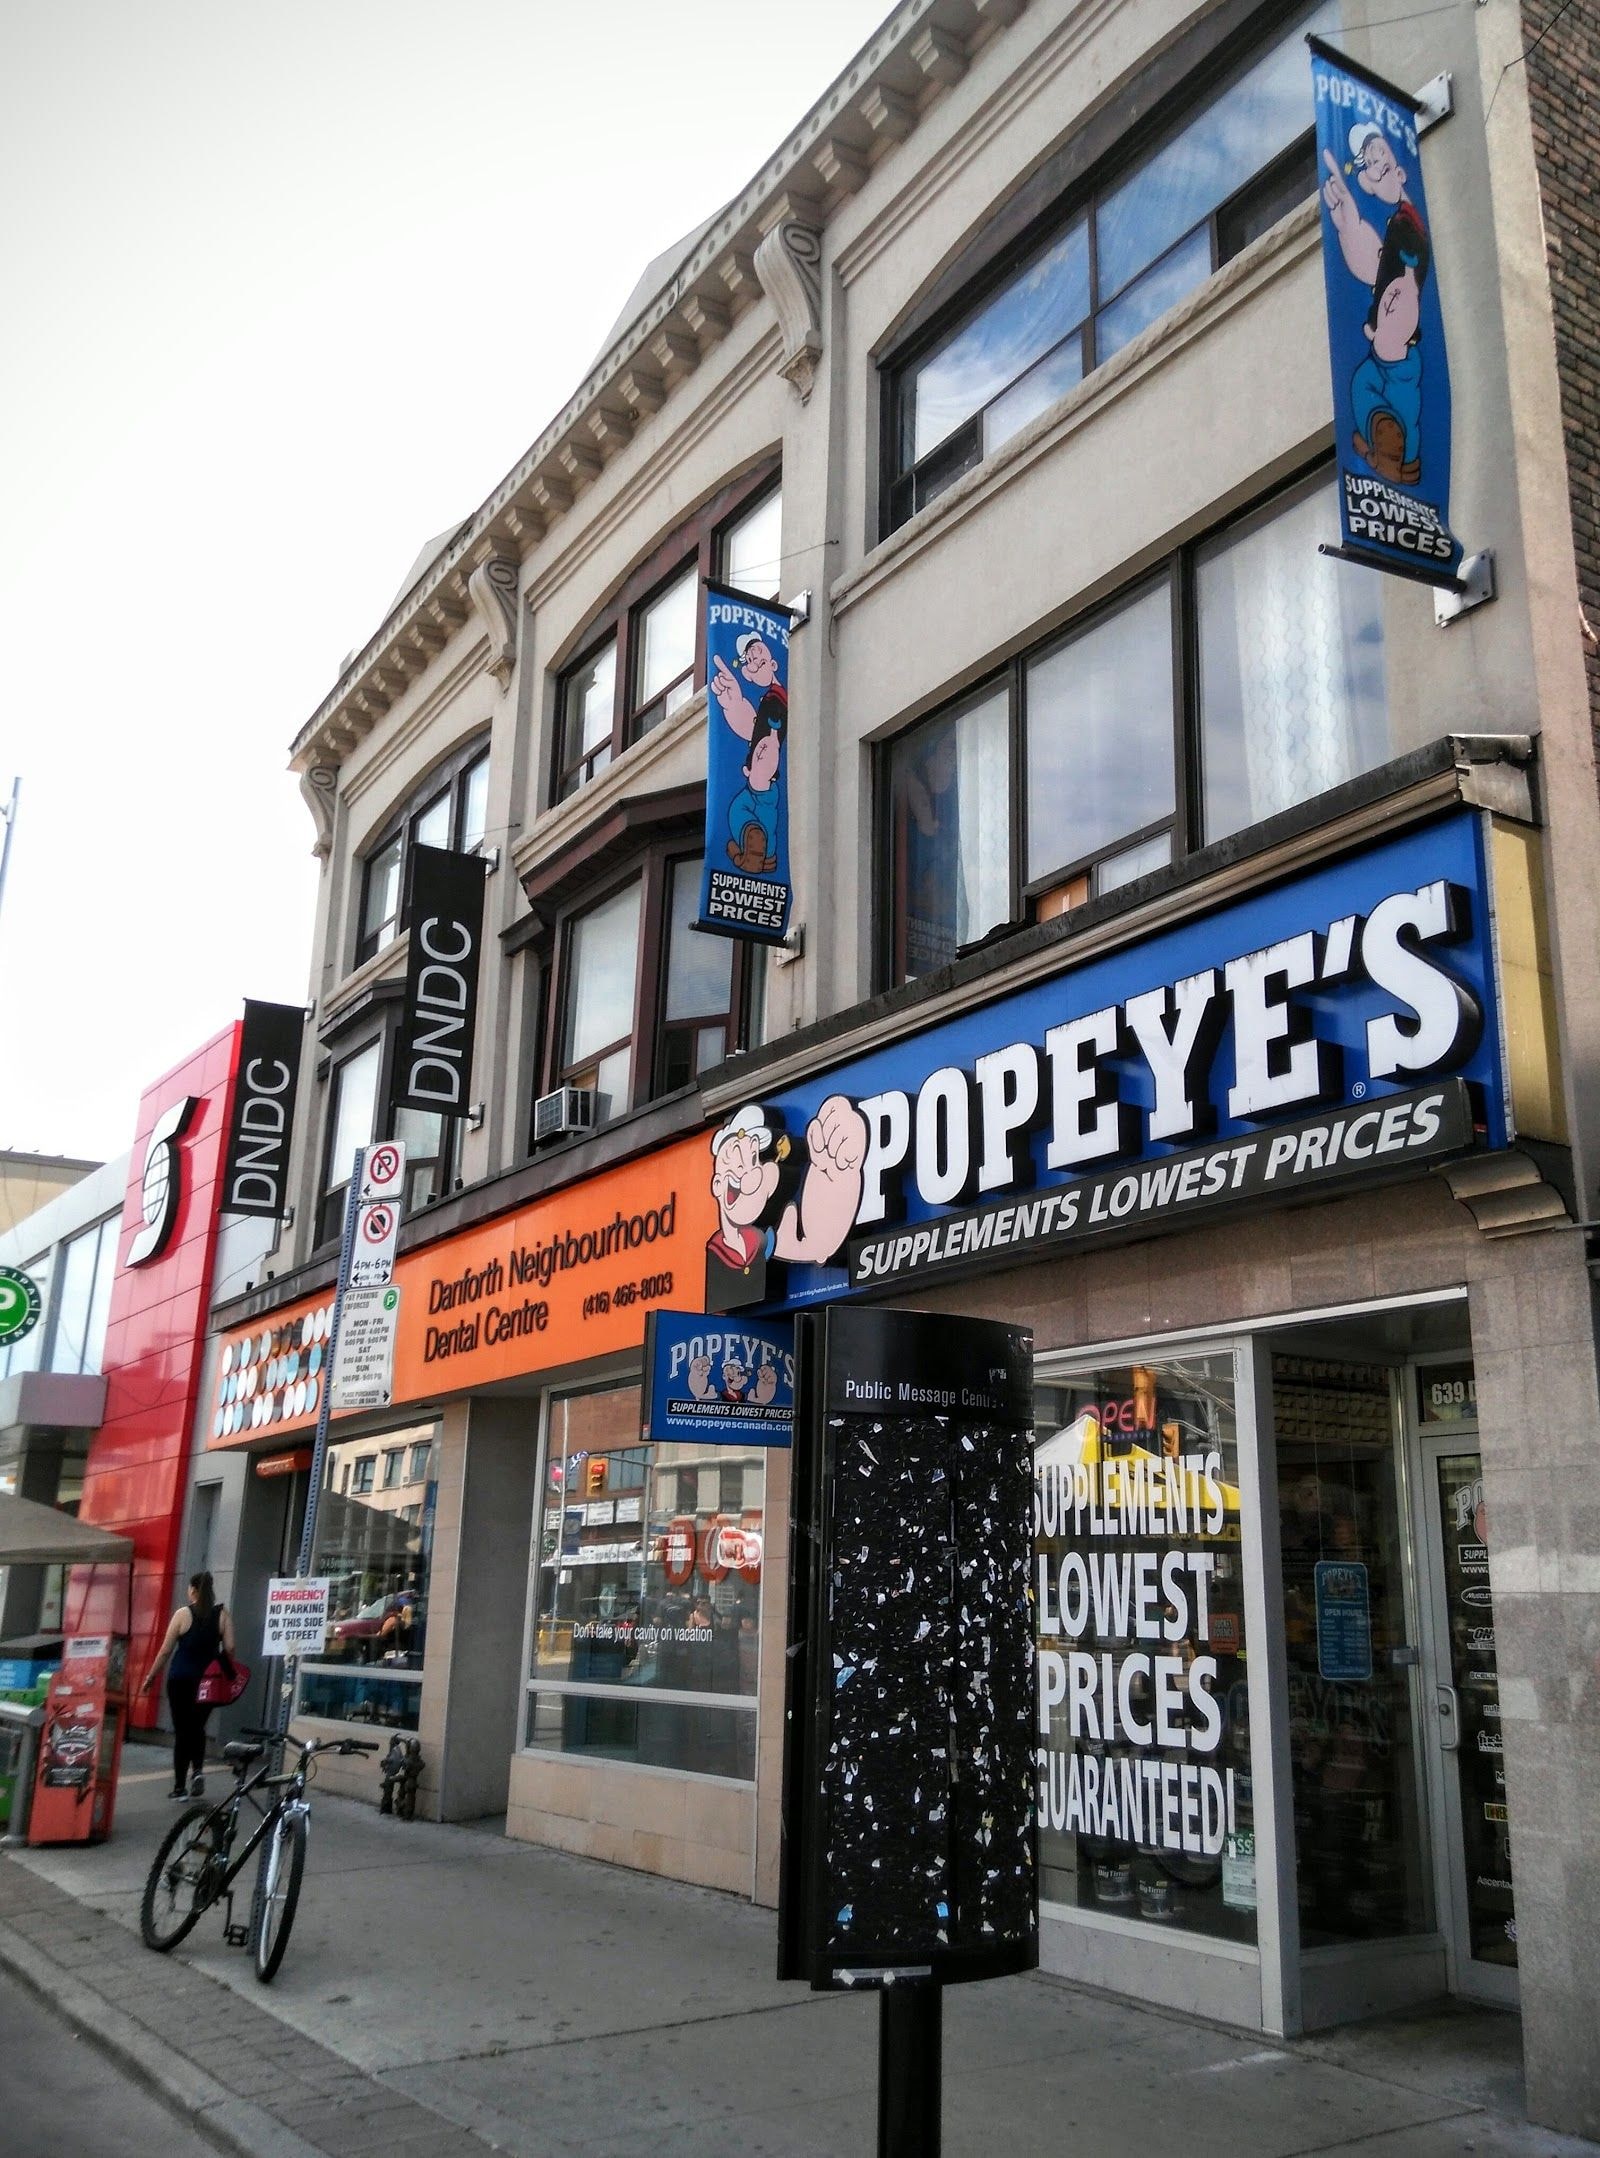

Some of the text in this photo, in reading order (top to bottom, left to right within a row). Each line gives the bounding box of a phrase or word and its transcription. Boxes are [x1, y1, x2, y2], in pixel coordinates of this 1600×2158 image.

[1316, 73, 1417, 156] POPEYE'S
[1345, 474, 1439, 523] SUPPLEMENTS
[1347, 495, 1445, 535] LOWEST
[1349, 515, 1452, 558] PRICES
[710, 604, 790, 649] POPEYE'S
[711, 887, 785, 913] LOWEST
[712, 872, 787, 899] SUPPLEMENTS
[709, 902, 783, 928] PRICES
[408, 917, 472, 1103] DNDC
[856, 879, 1460, 1225] POPEYE'S
[231, 1057, 291, 1208] DNDC
[856, 1093, 1445, 1282] SUPPLEMENTS LOWEST PRICES
[428, 1191, 676, 1315] Danforth Neighbourhood
[583, 1271, 673, 1320] (416) 466-8003
[353, 1317, 384, 1327] MON FRI
[424, 1299, 549, 1363] Dental Centre
[356, 1364, 369, 1372] SUN
[358, 1345, 371, 1354] SAT
[669, 1333, 795, 1389] POPEYE'S
[671, 1402, 792, 1419] SUPPLEMENTS LOWEST PRICES
[845, 1380, 892, 1400] Public
[899, 1382, 956, 1408] Message
[1431, 1381, 1465, 1405] 639
[269, 1603, 325, 1615] NO PARKING
[271, 1589, 326, 1601] EMERGENCY
[1038, 1550, 1214, 1641] LOWEST
[268, 1617, 324, 1628] ON THIS SIDE
[271, 1630, 318, 1641] OF STREET
[573, 1622, 713, 1643] Don't take your cavity on vacation
[1038, 1650, 1222, 1752] PRICES
[1037, 1748, 1237, 1859] GUARANTEED!
